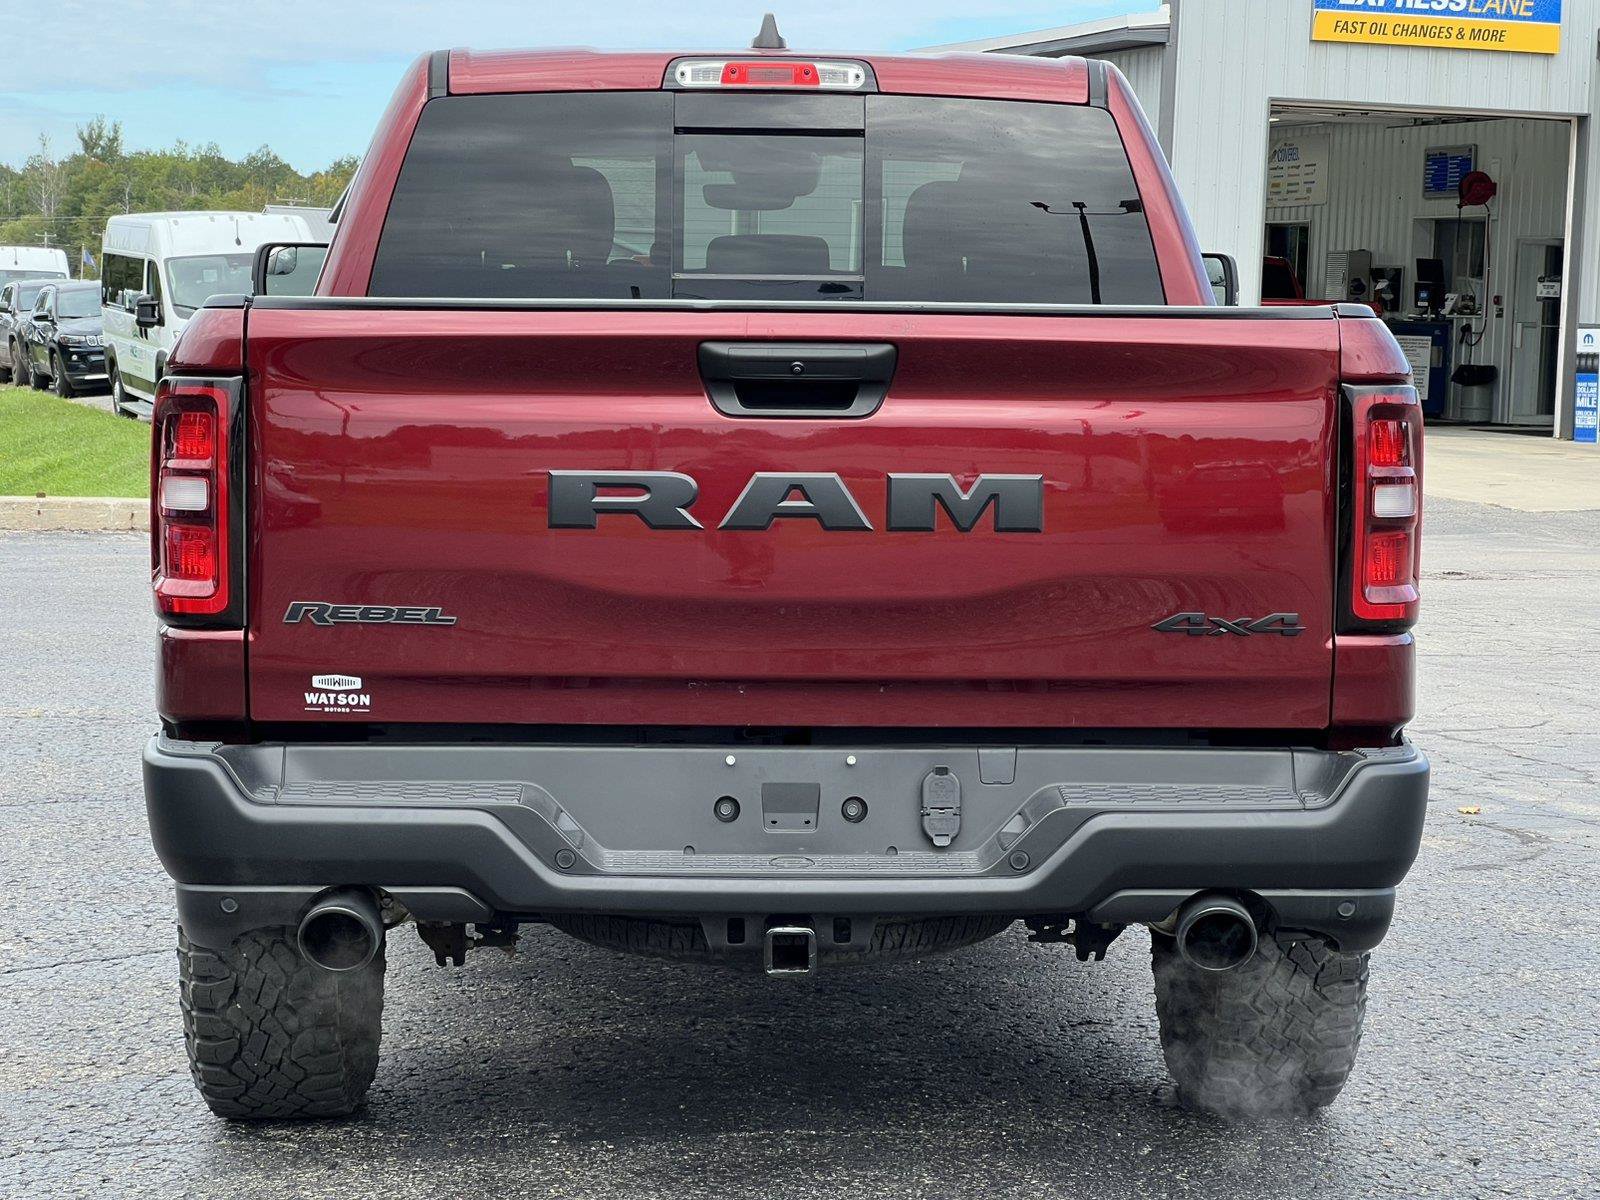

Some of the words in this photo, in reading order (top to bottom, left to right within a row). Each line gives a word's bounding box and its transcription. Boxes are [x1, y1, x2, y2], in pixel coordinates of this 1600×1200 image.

[1334, 20, 1367, 35] FAST
[1369, 22, 1388, 36] OIL
[1392, 23, 1453, 40] CHANGES
[1456, 27, 1465, 40] &
[1469, 28, 1506, 43] MORE
[1576, 397, 1597, 408] MILE
[548, 470, 1044, 533] RAM
[283, 601, 457, 626] REBEL
[304, 692, 370, 706] WATSON
